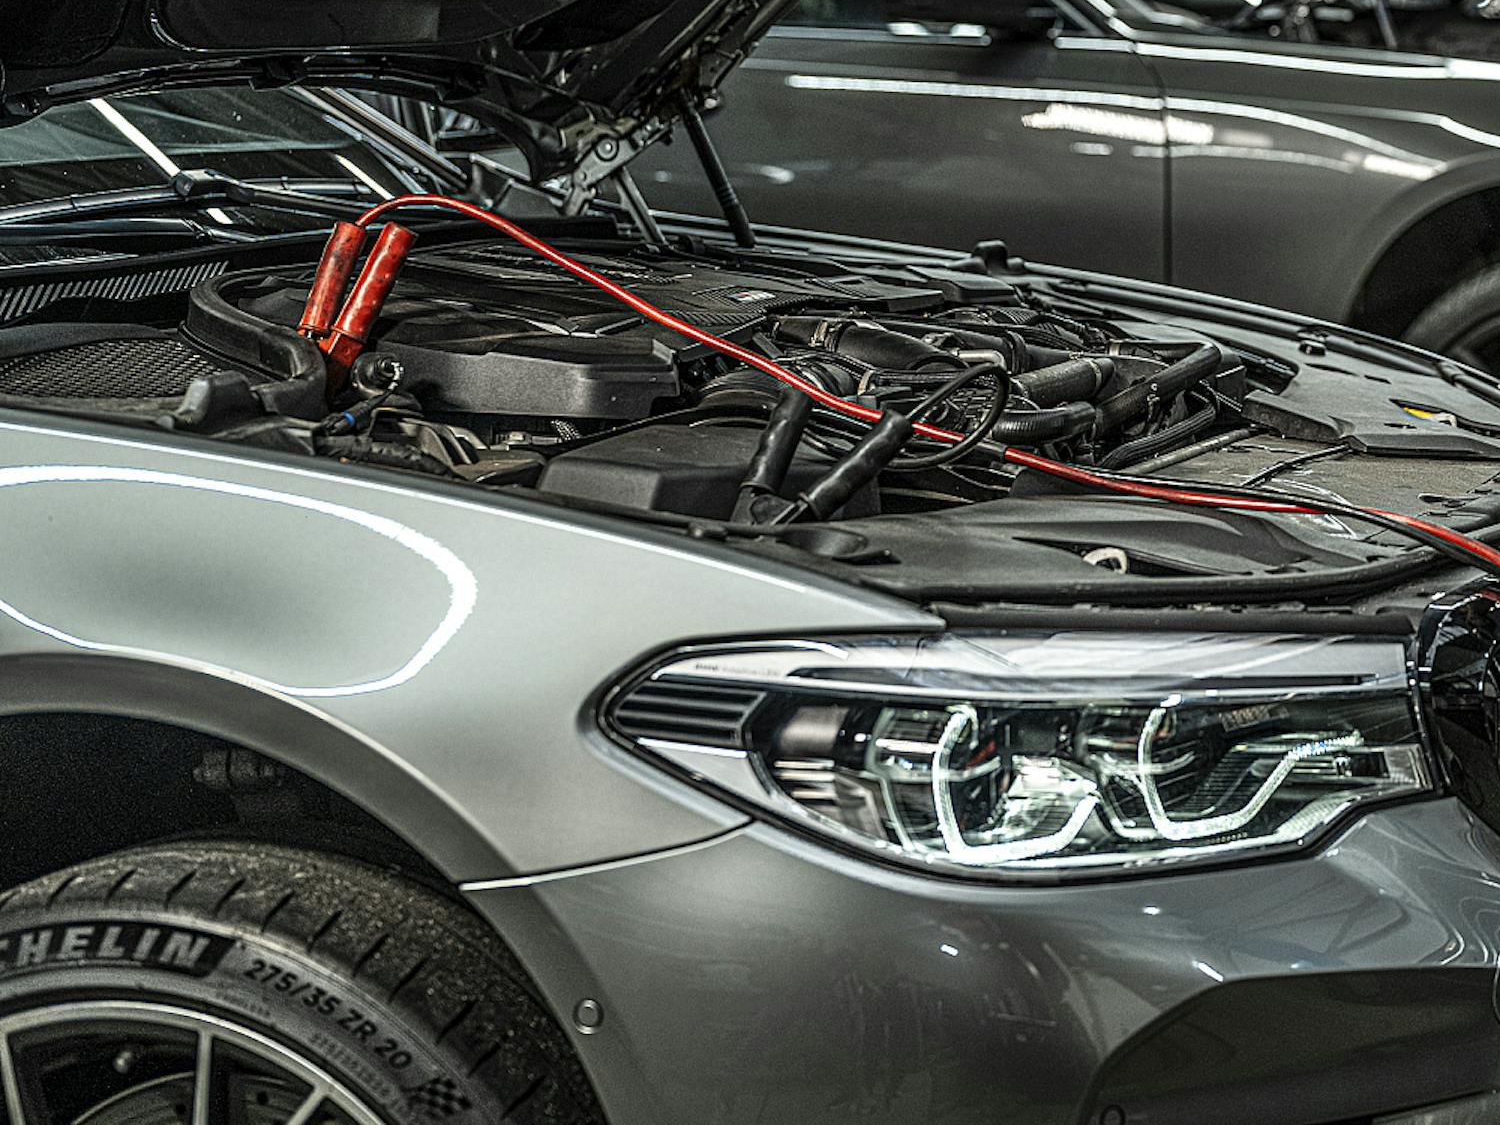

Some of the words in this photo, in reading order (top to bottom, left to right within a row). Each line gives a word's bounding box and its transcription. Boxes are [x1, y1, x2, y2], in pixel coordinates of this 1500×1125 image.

[0, 926, 211, 970] HELIN
[244, 958, 342, 1016] 275/35
[338, 1009, 378, 1041] ZR
[374, 1038, 413, 1071] 20
